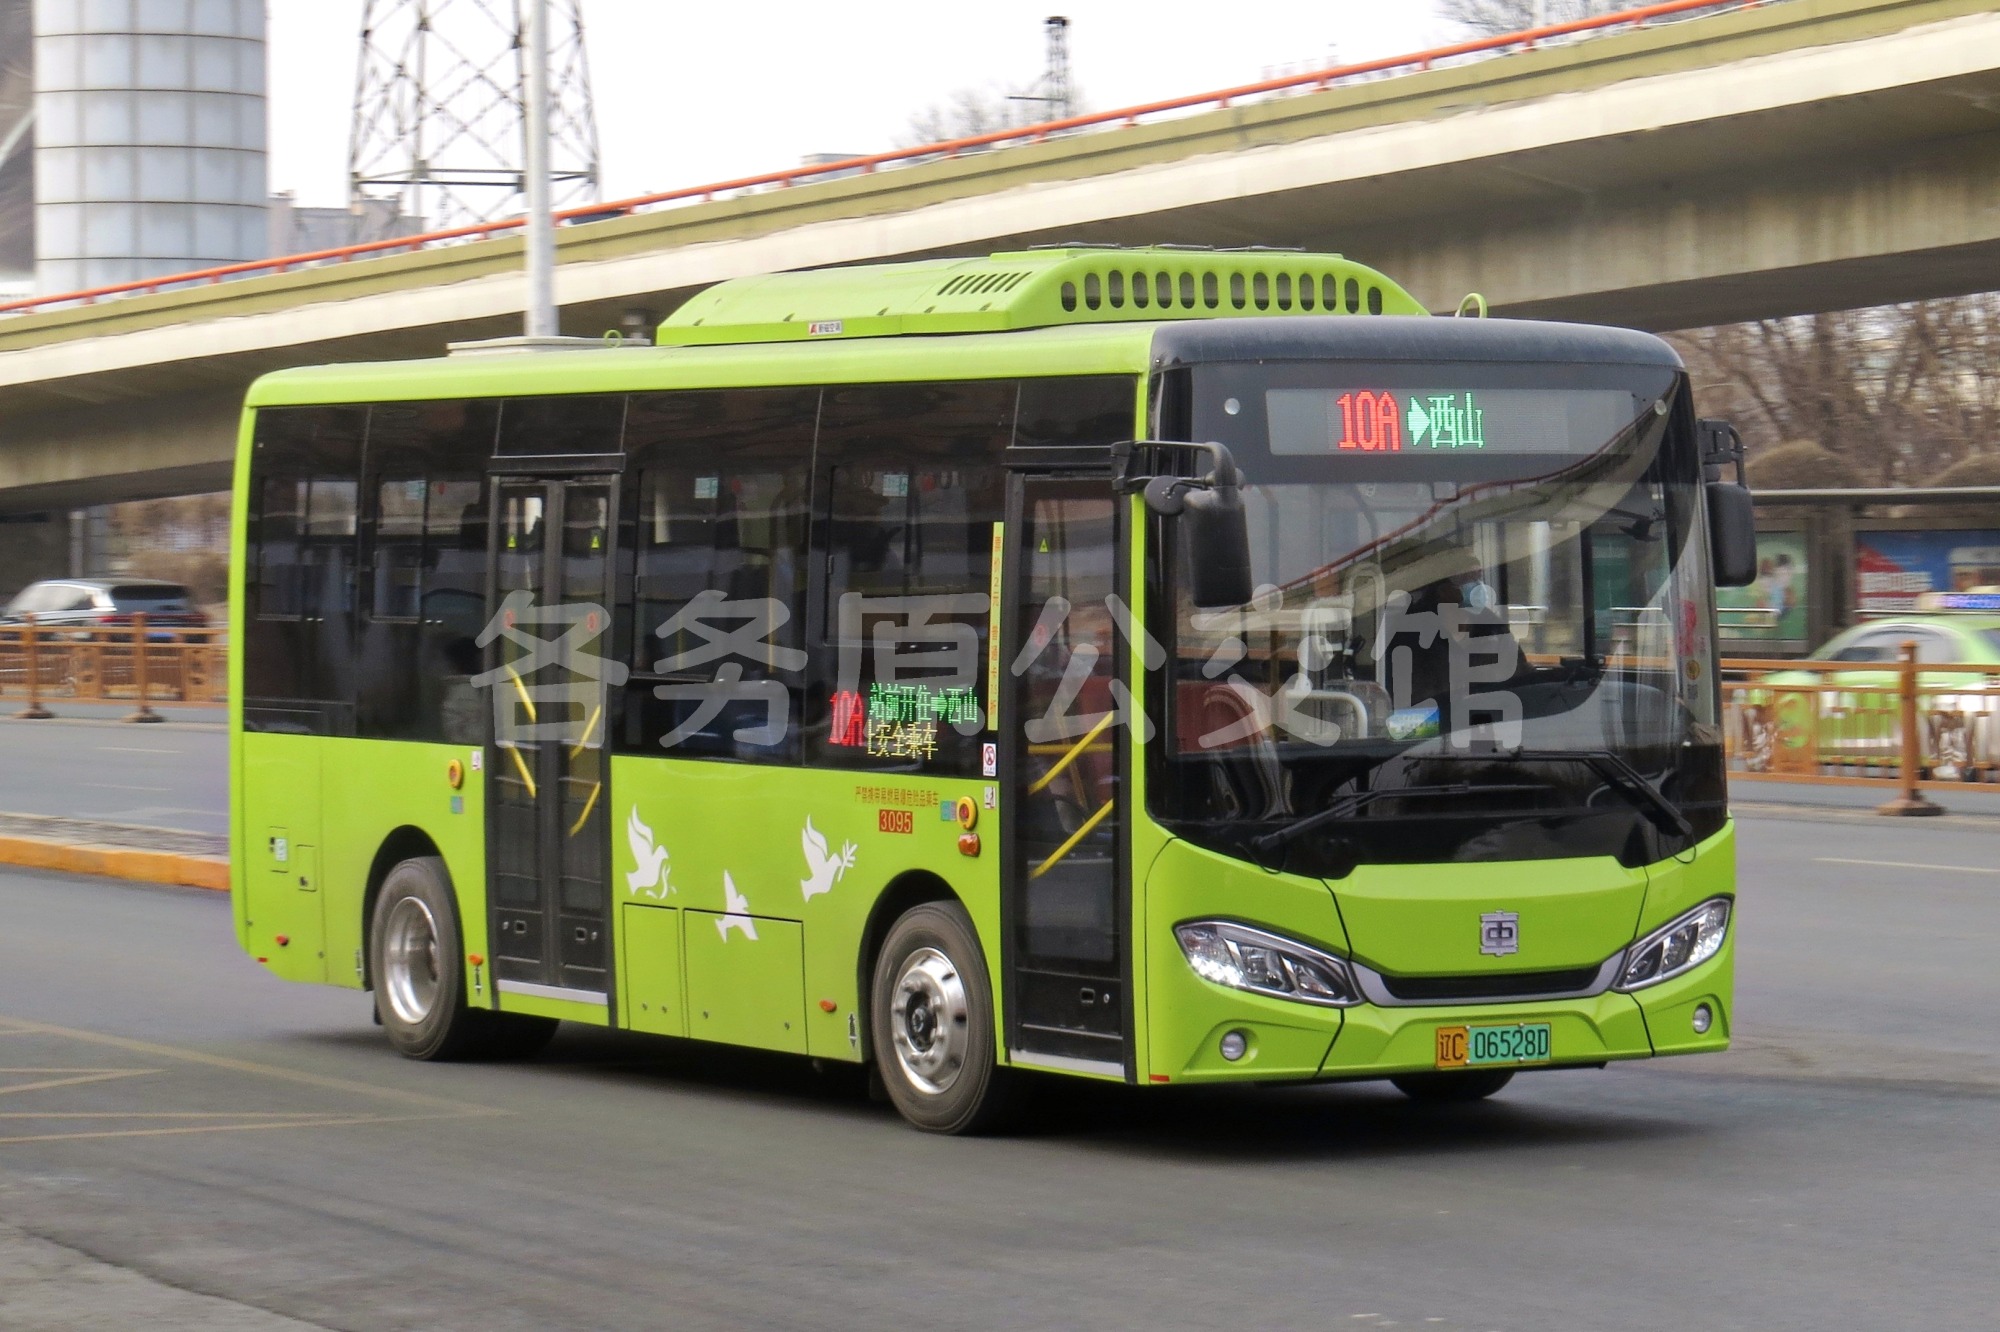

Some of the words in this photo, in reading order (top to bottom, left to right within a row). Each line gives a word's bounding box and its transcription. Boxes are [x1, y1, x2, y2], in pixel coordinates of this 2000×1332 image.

[1336, 391, 1400, 451] 10A
[1427, 392, 1485, 449] 西山
[829, 690, 865, 747] 10A
[880, 810, 912, 833] 3095
